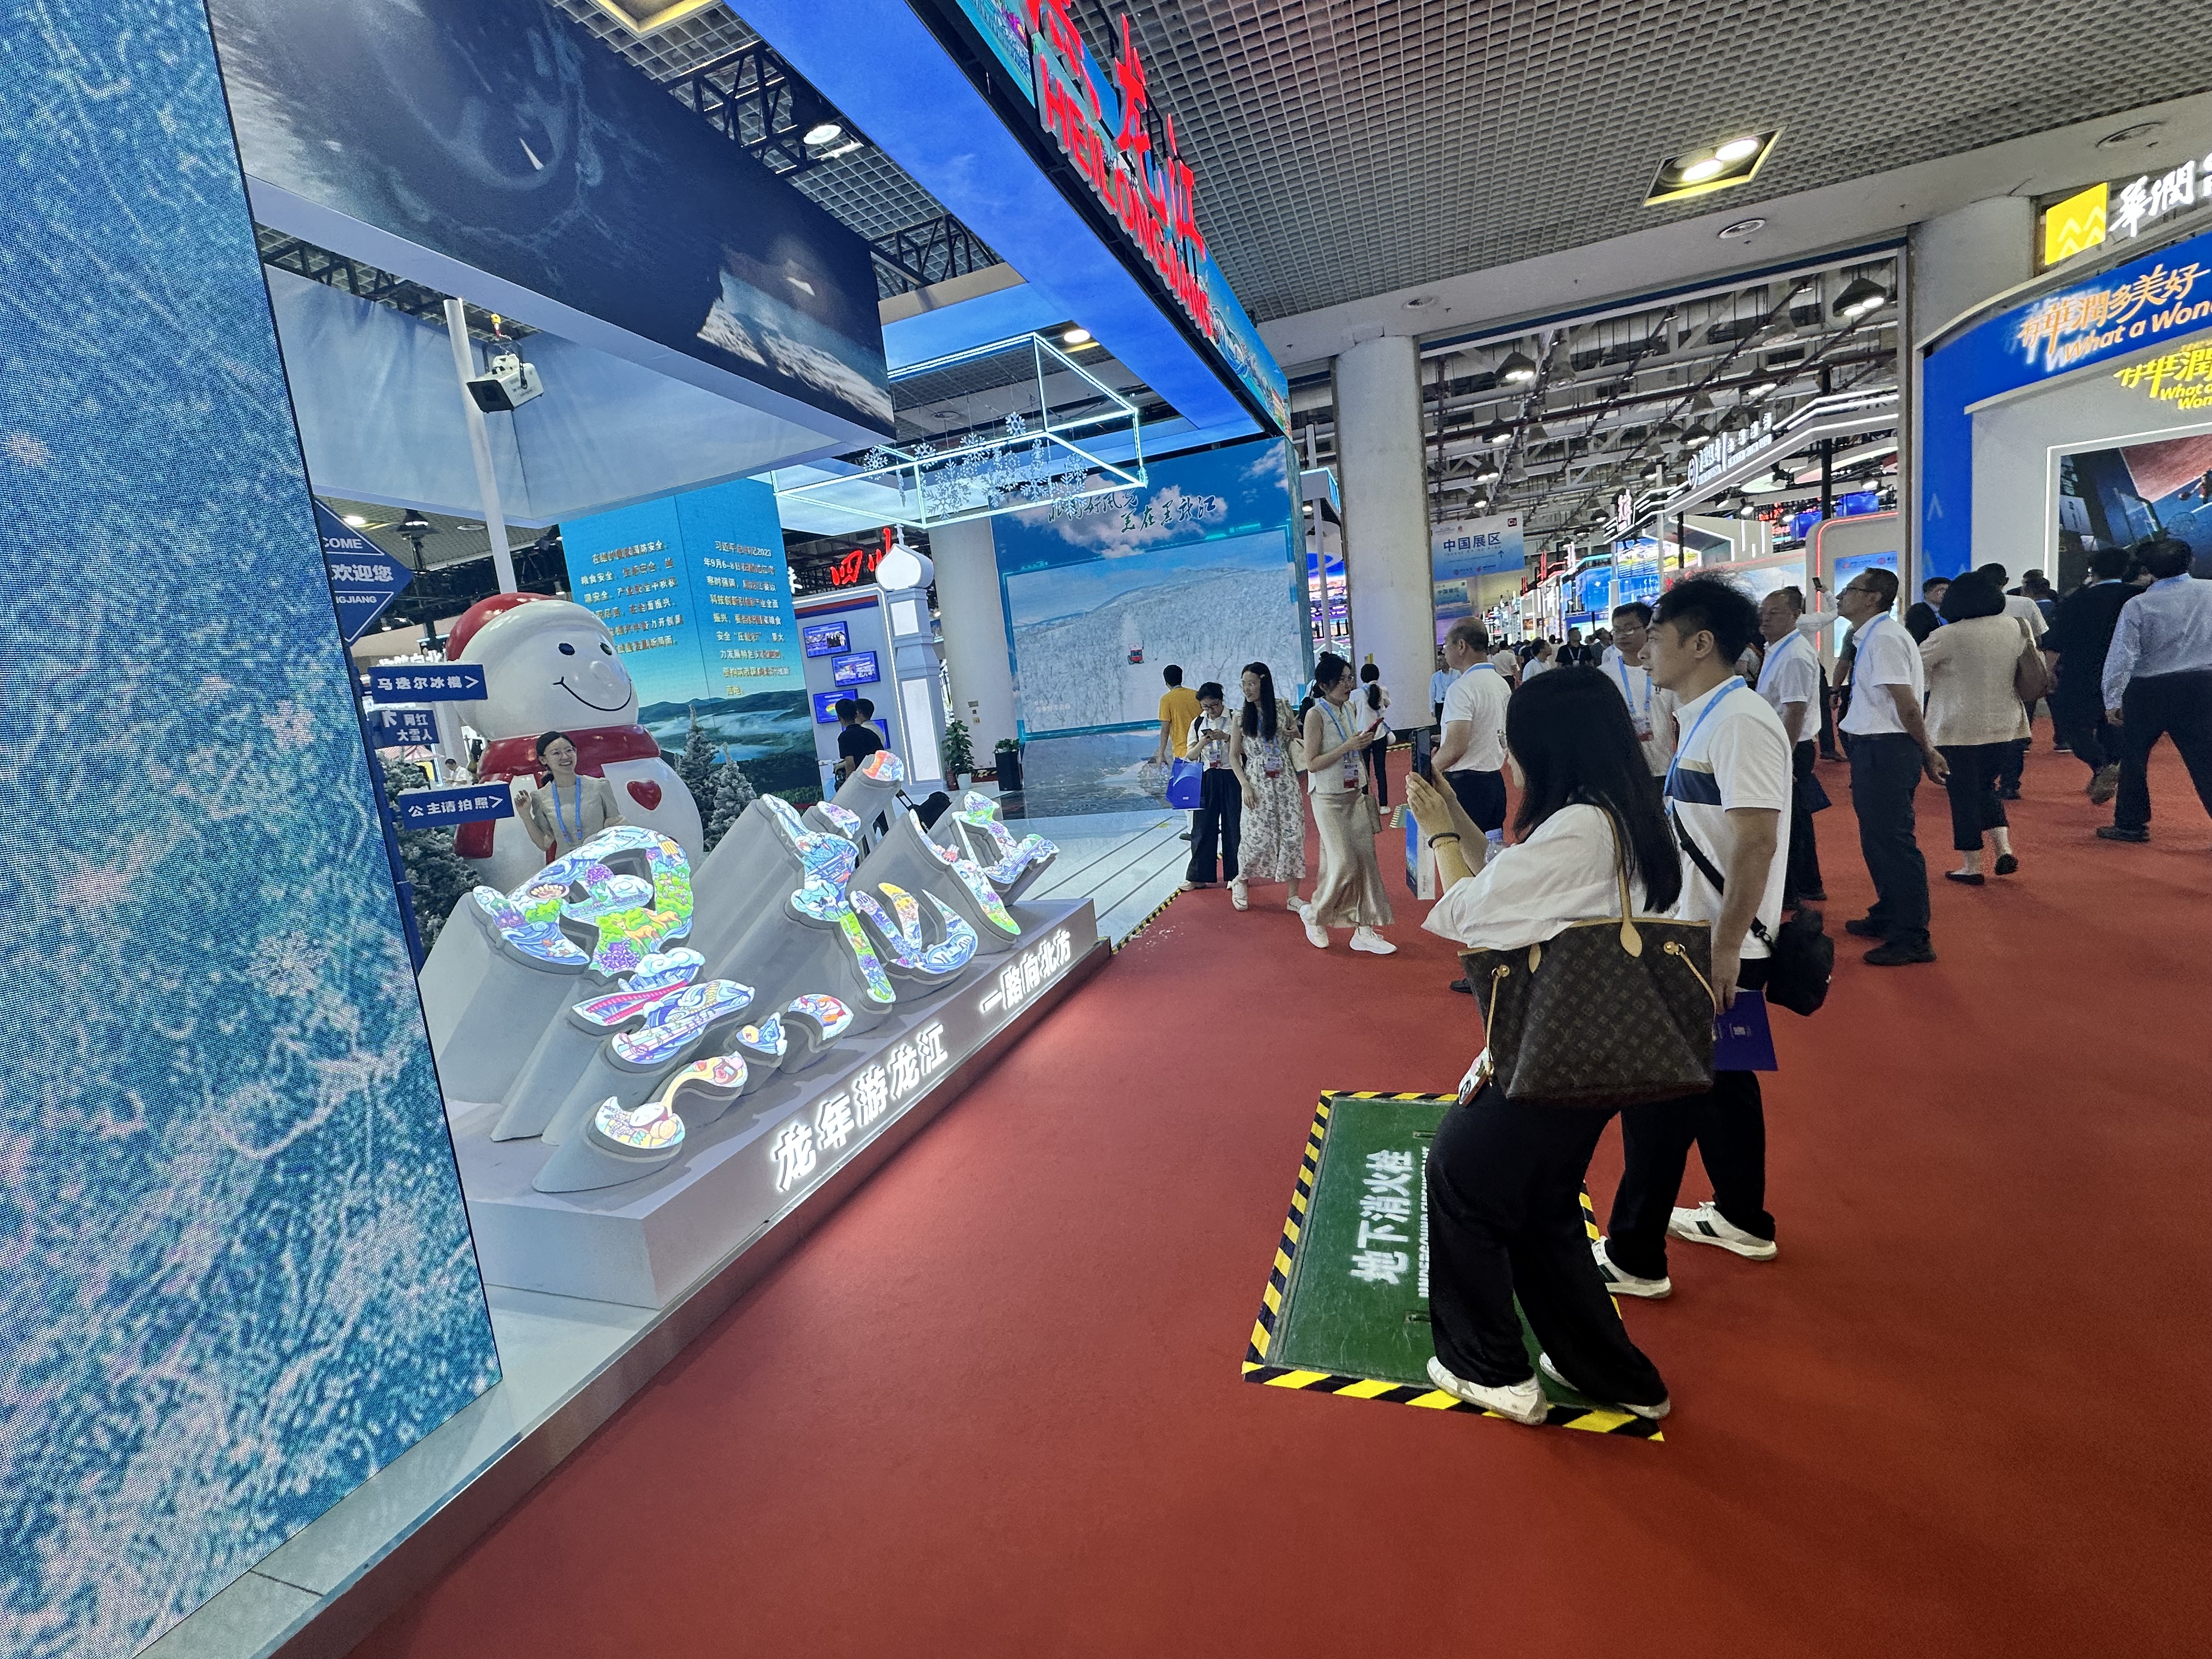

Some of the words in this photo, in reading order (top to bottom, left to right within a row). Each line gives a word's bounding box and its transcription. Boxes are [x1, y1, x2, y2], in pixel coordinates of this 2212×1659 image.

[1040, 53, 1212, 337] HEILONGJIANG
[2065, 326, 2126, 360] What
[2129, 320, 2146, 337] a
[2152, 301, 2212, 332] Won
[2160, 383, 2204, 400] What
[1443, 532, 1502, 552] 中国展区
[330, 564, 394, 582] 欢迎您
[403, 713, 428, 726] 网红
[397, 729, 433, 742] 大雪人
[408, 797, 489, 817] 公主请拍照
[771, 1023, 950, 1191] 龙年游龙江
[980, 929, 1072, 1012] 一路向北方
[1350, 1149, 1414, 1285] 地下消火栓
